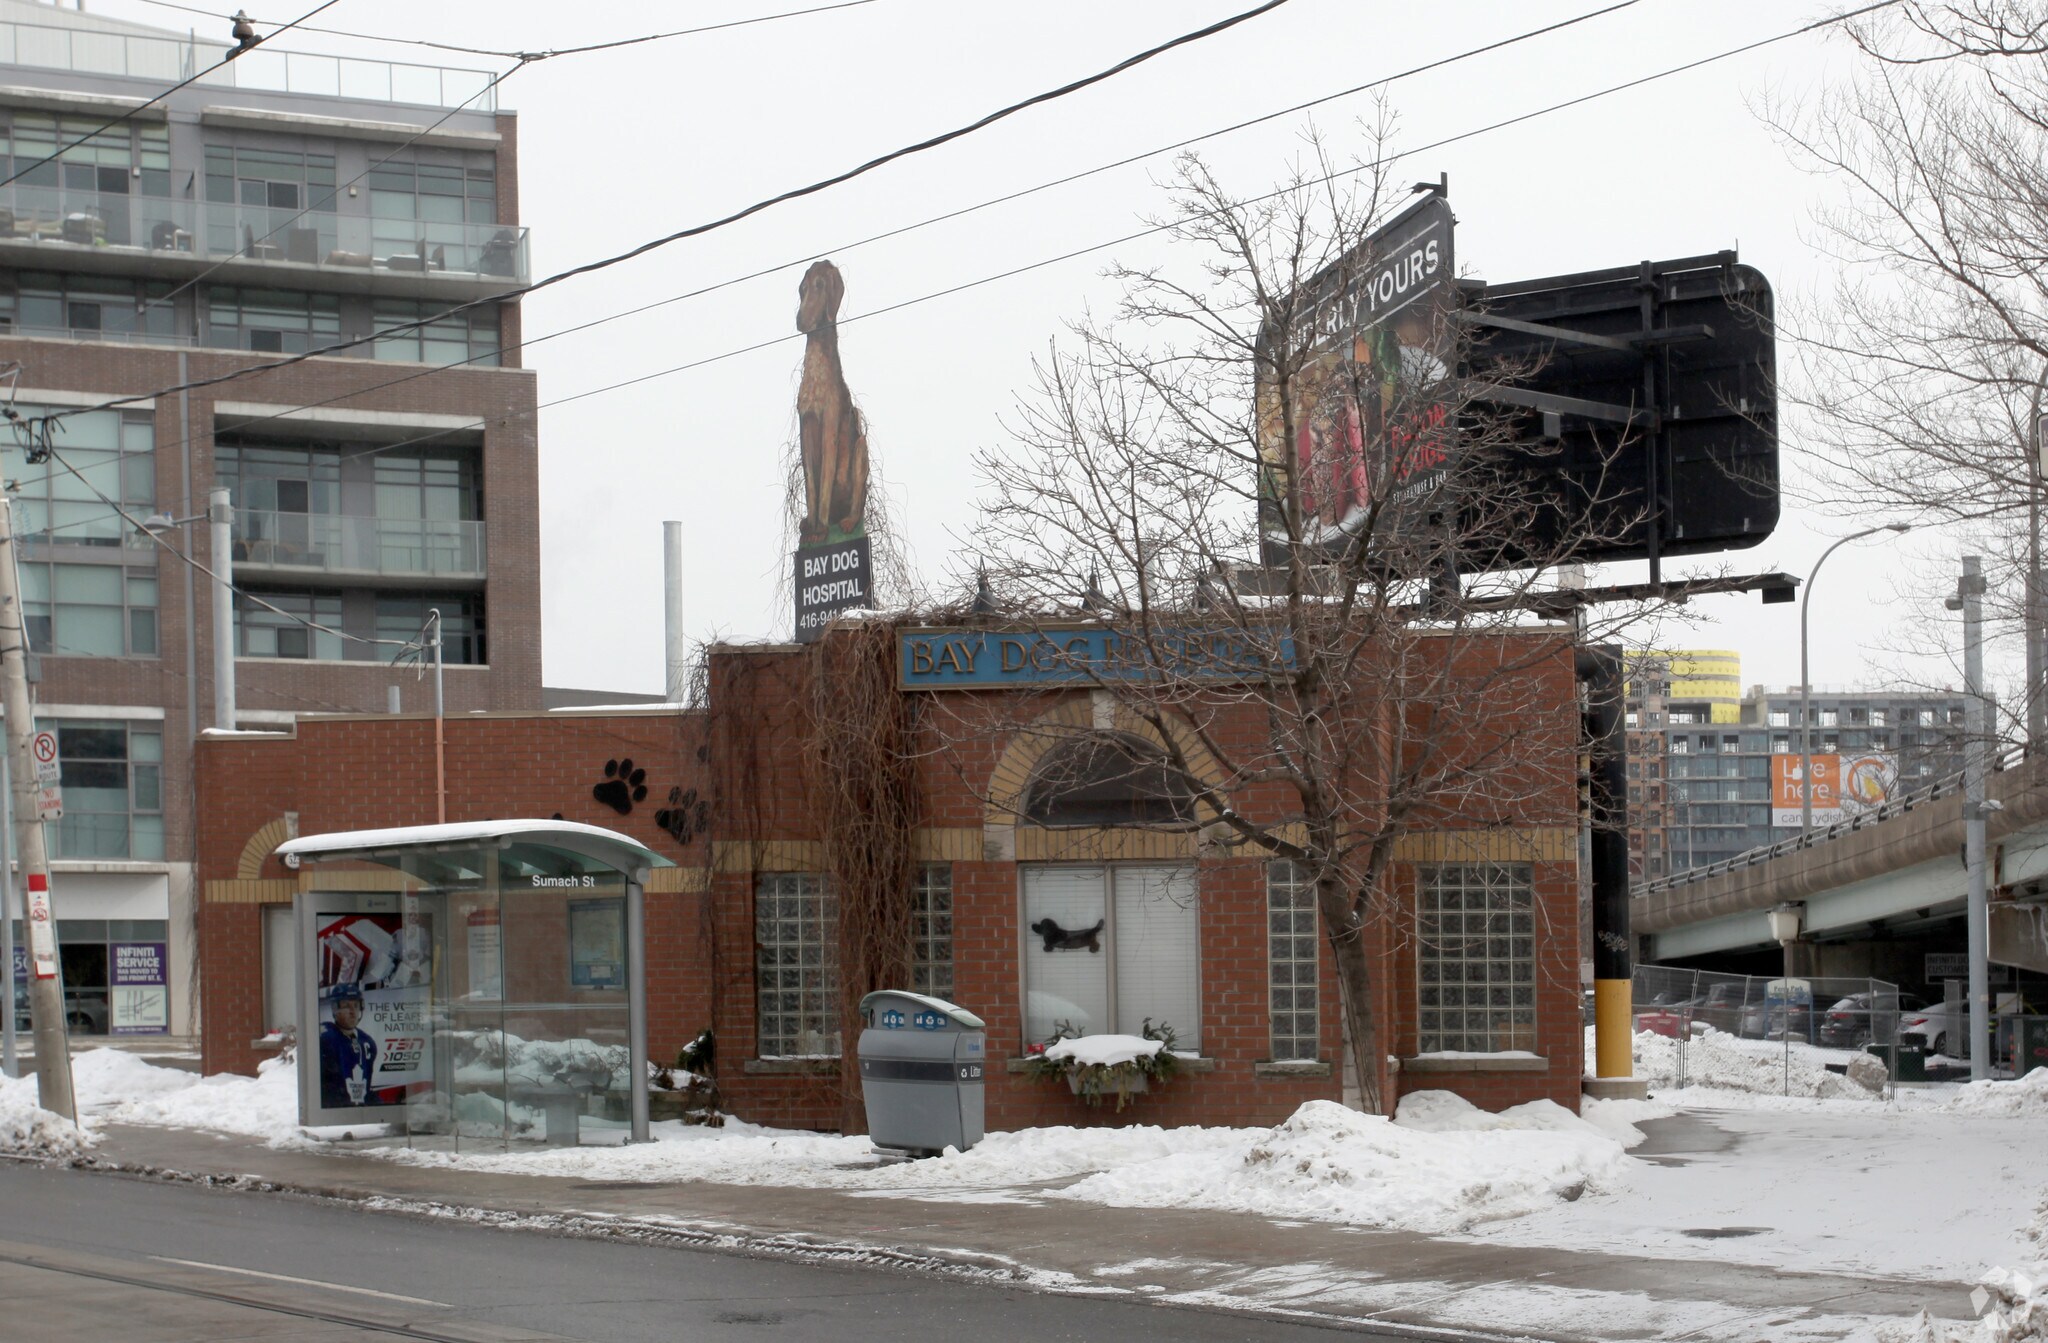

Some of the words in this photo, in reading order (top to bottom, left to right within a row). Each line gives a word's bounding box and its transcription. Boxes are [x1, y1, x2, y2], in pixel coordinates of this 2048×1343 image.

[1367, 240, 1438, 311] YOURS
[804, 556, 828, 578] BAY
[832, 549, 859, 572] DOG
[803, 578, 863, 606] HOSPITAL
[911, 639, 983, 675] BAY
[1001, 637, 1092, 672] DOG
[532, 875, 578, 887] Sumach
[582, 876, 595, 887] St
[117, 947, 155, 957] INFINITI
[117, 957, 160, 968] SERVICE
[368, 1003, 390, 1011] THE
[374, 1013, 388, 1022] OF
[384, 1023, 424, 1032] NATION
[384, 1038, 425, 1050] TSN
